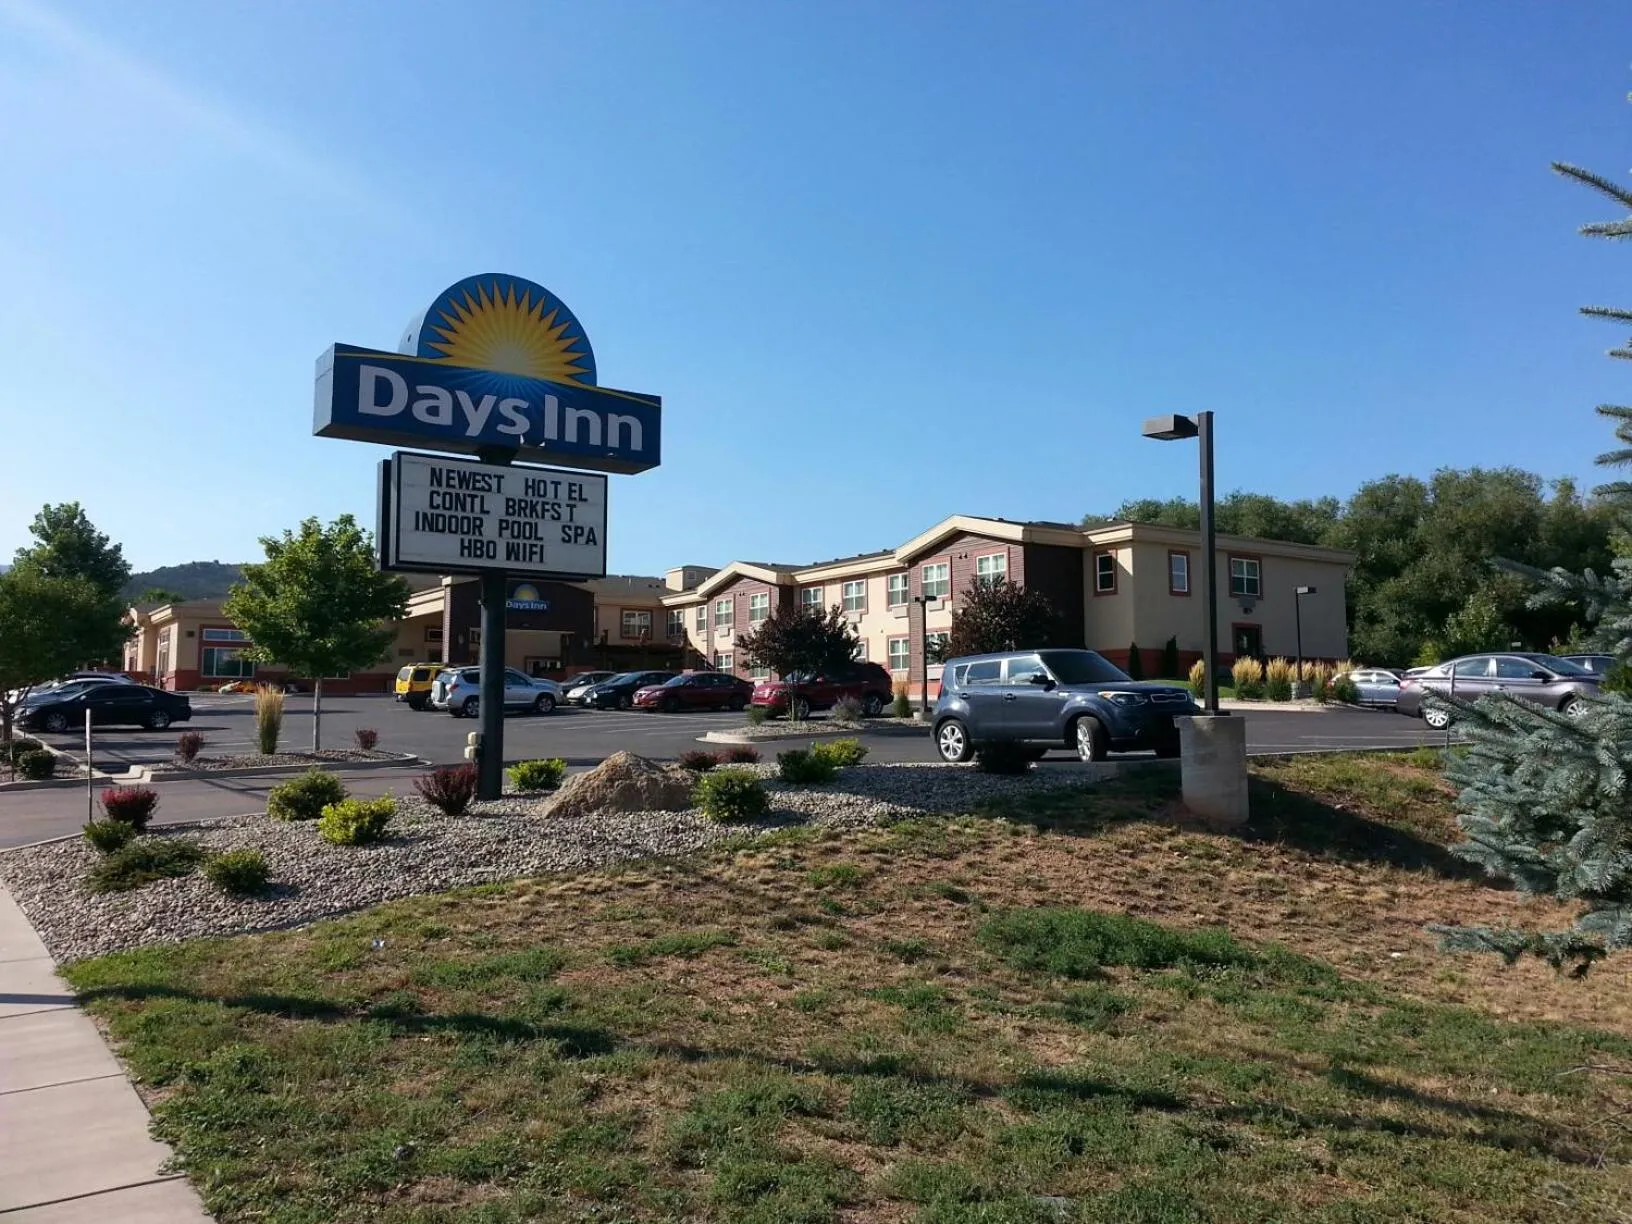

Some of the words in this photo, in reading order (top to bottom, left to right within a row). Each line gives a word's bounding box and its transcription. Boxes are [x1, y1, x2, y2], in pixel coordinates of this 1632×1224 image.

[358, 364, 531, 438] Days
[544, 394, 643, 452] Inn
[430, 467, 505, 494] NEWEST
[524, 477, 588, 502] HOTEL
[429, 491, 490, 515] CONTL
[505, 499, 577, 522] BRKFST
[415, 511, 484, 536] INDOOR
[498, 518, 544, 542] POOL
[561, 525, 598, 546] SPA
[460, 540, 497, 561] HBO
[505, 543, 545, 564] WIFI
[505, 600, 529, 609] Days
[530, 602, 547, 610] Inn
